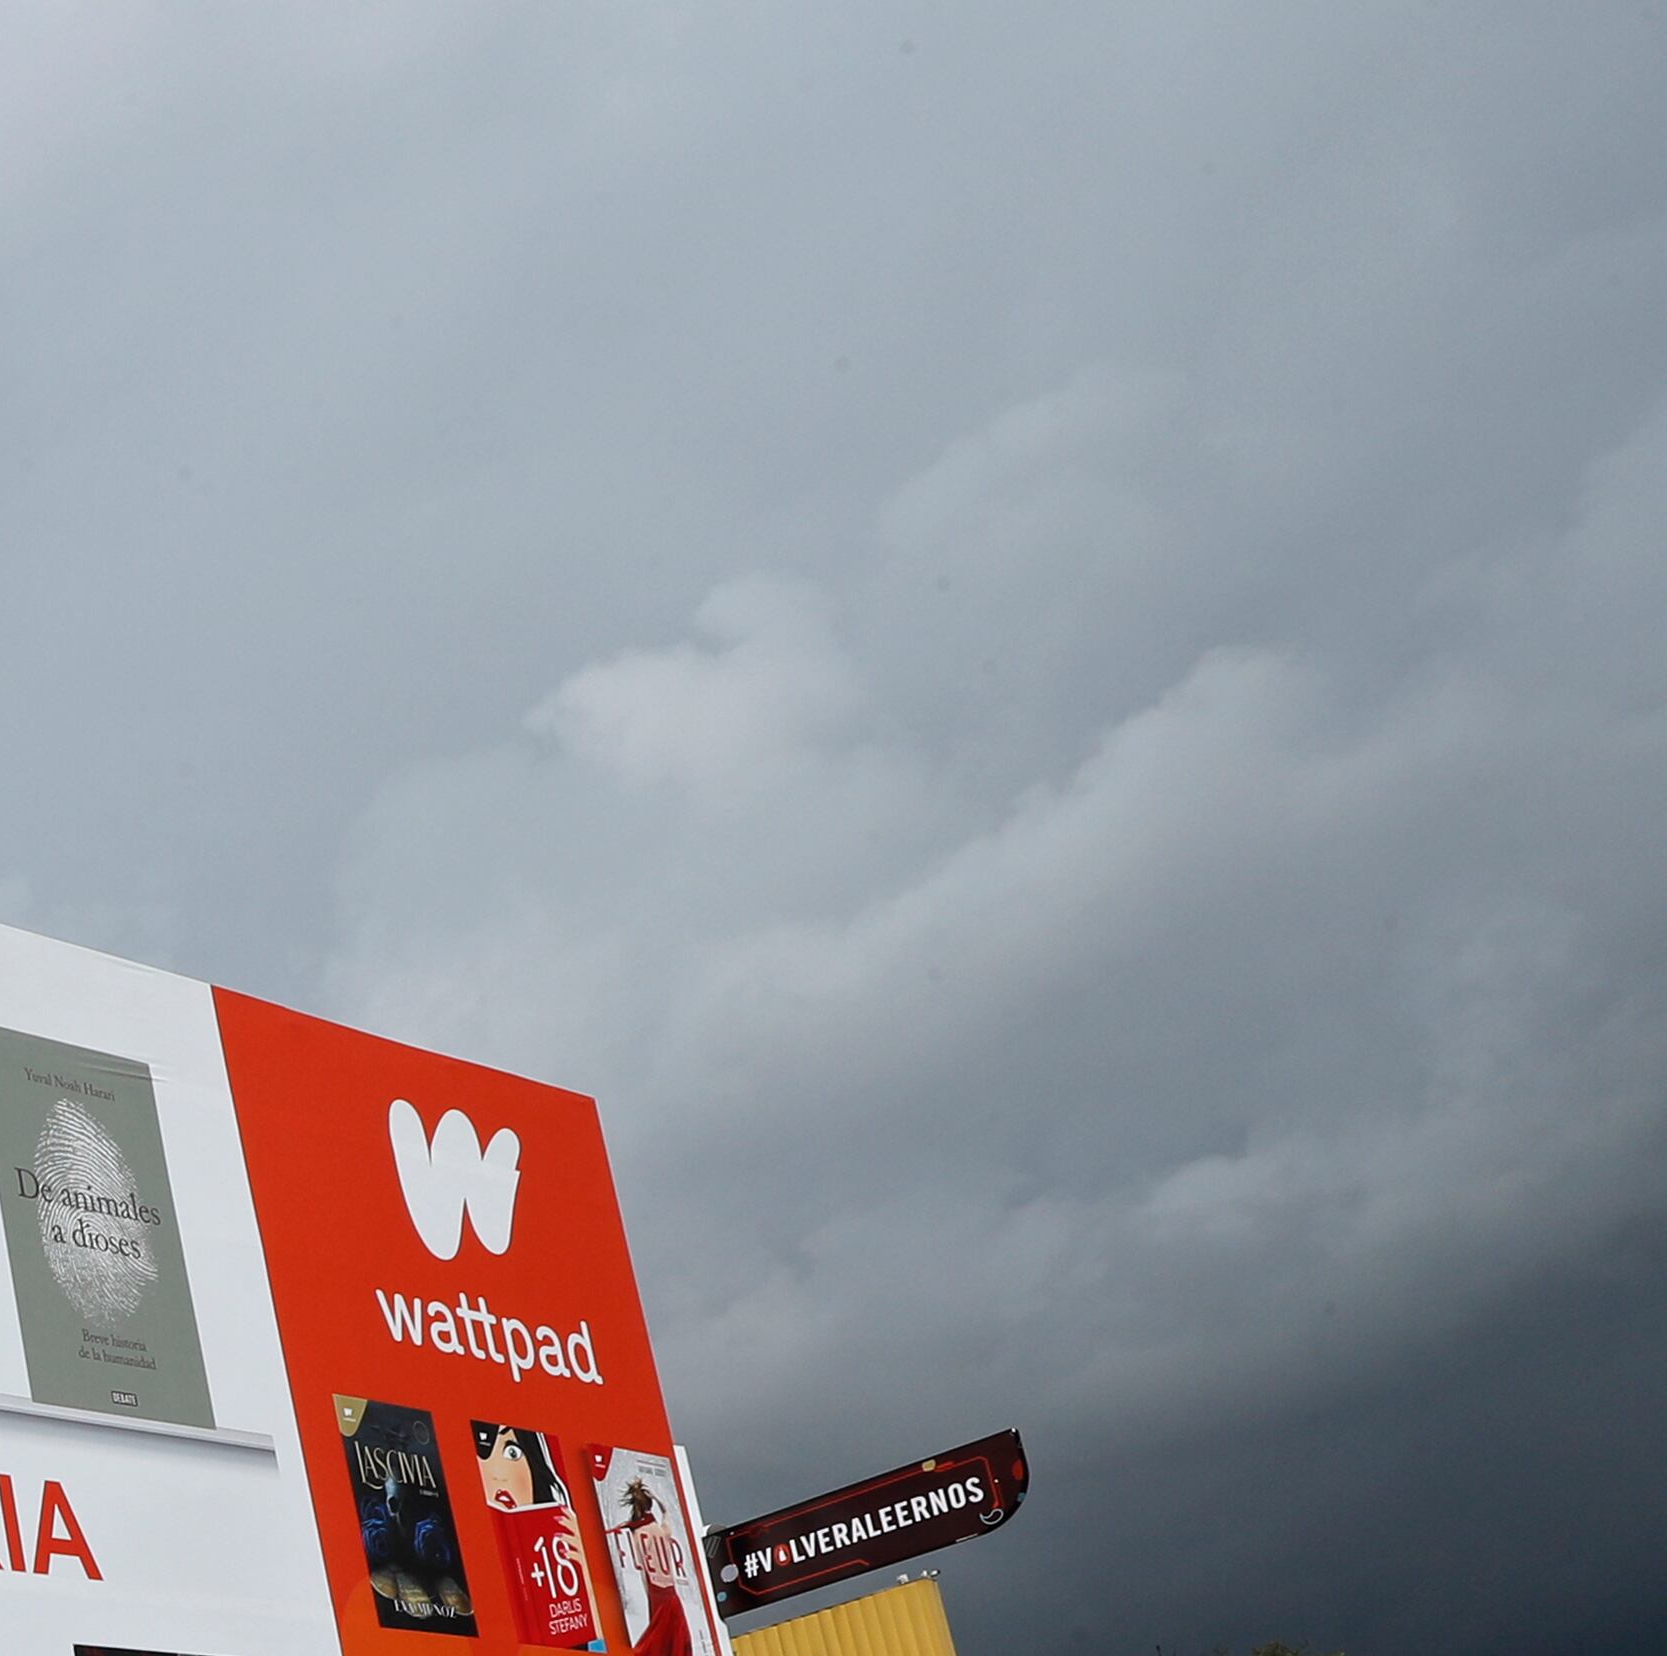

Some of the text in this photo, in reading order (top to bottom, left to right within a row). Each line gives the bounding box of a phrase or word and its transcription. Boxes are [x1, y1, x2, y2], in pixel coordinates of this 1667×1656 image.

[13, 1167, 161, 1226] De animales
[72, 1218, 141, 1259] dioses
[375, 1288, 604, 1385] wattpad
[355, 1441, 437, 1490] LASCIVIA
[614, 1528, 687, 1578] FLEUR
[744, 1477, 985, 1579] #VOLVERALEERNOS
[531, 1536, 579, 1599] +18
[549, 1598, 582, 1618] DARLIS
[549, 1614, 587, 1635] STEFANY
